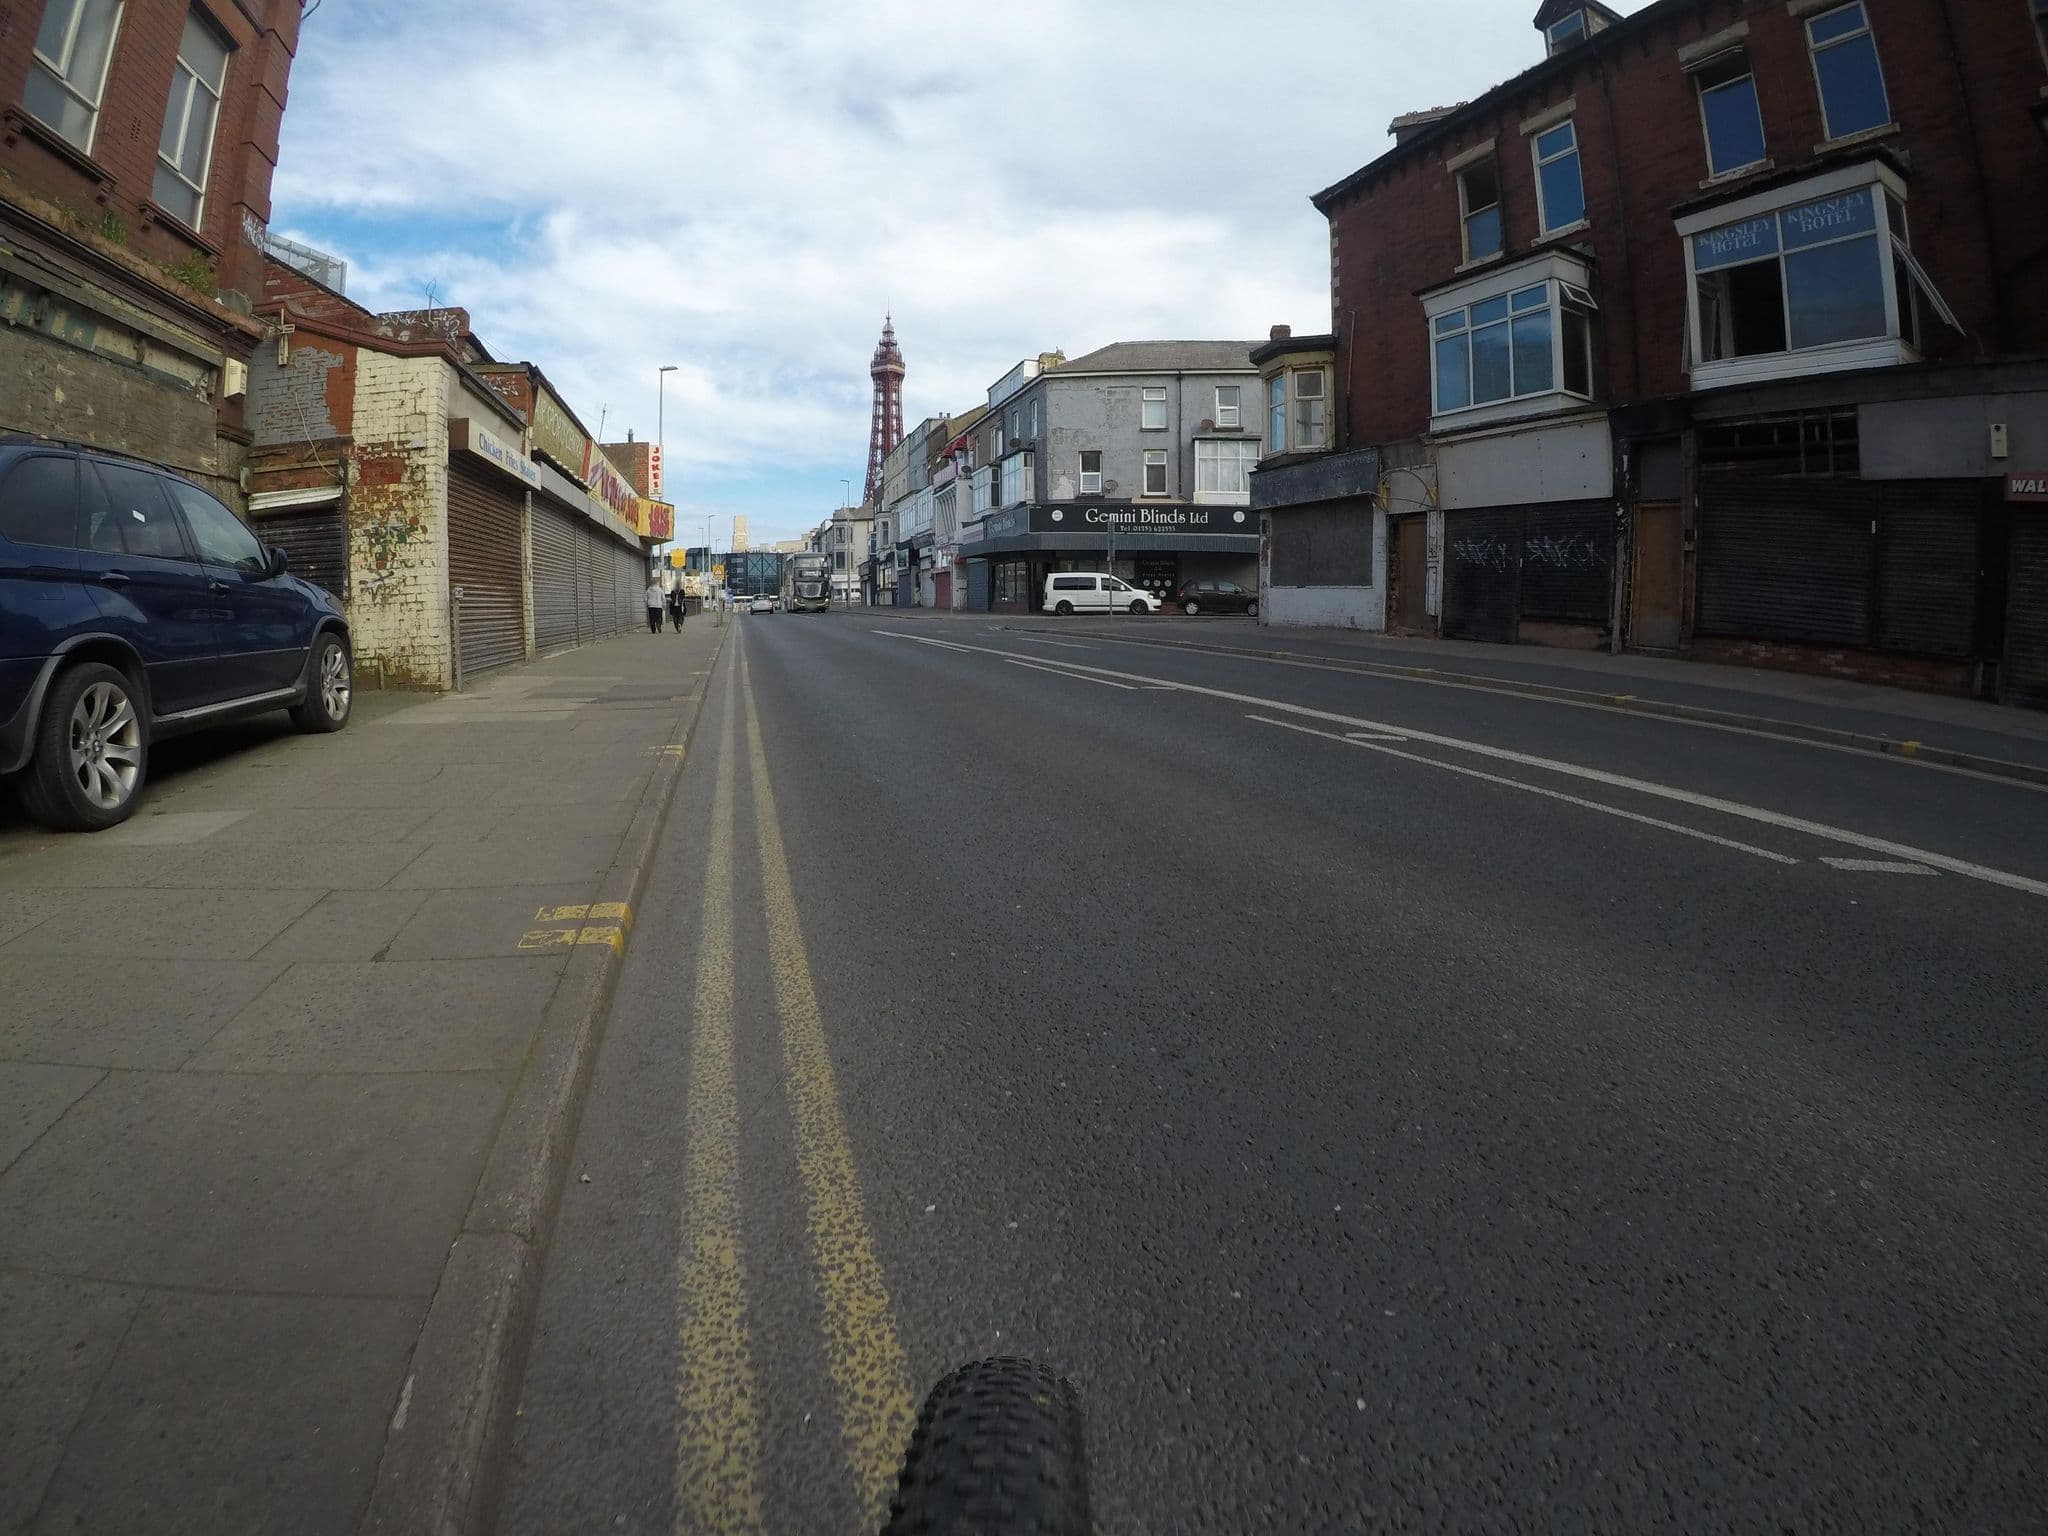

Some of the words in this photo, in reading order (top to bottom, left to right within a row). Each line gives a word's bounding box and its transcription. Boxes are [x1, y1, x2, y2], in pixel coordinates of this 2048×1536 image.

[1787, 193, 1866, 224] KINGSLEY
[1801, 208, 1856, 233] HOTEL
[1699, 219, 1771, 247] KINGSLEY
[1711, 234, 1761, 255] HOTEL
[652, 447, 660, 488] JOKES
[1085, 508, 1136, 523] Gemini
[1140, 508, 1186, 524] Blinds
[1189, 511, 1208, 524] Ltd
